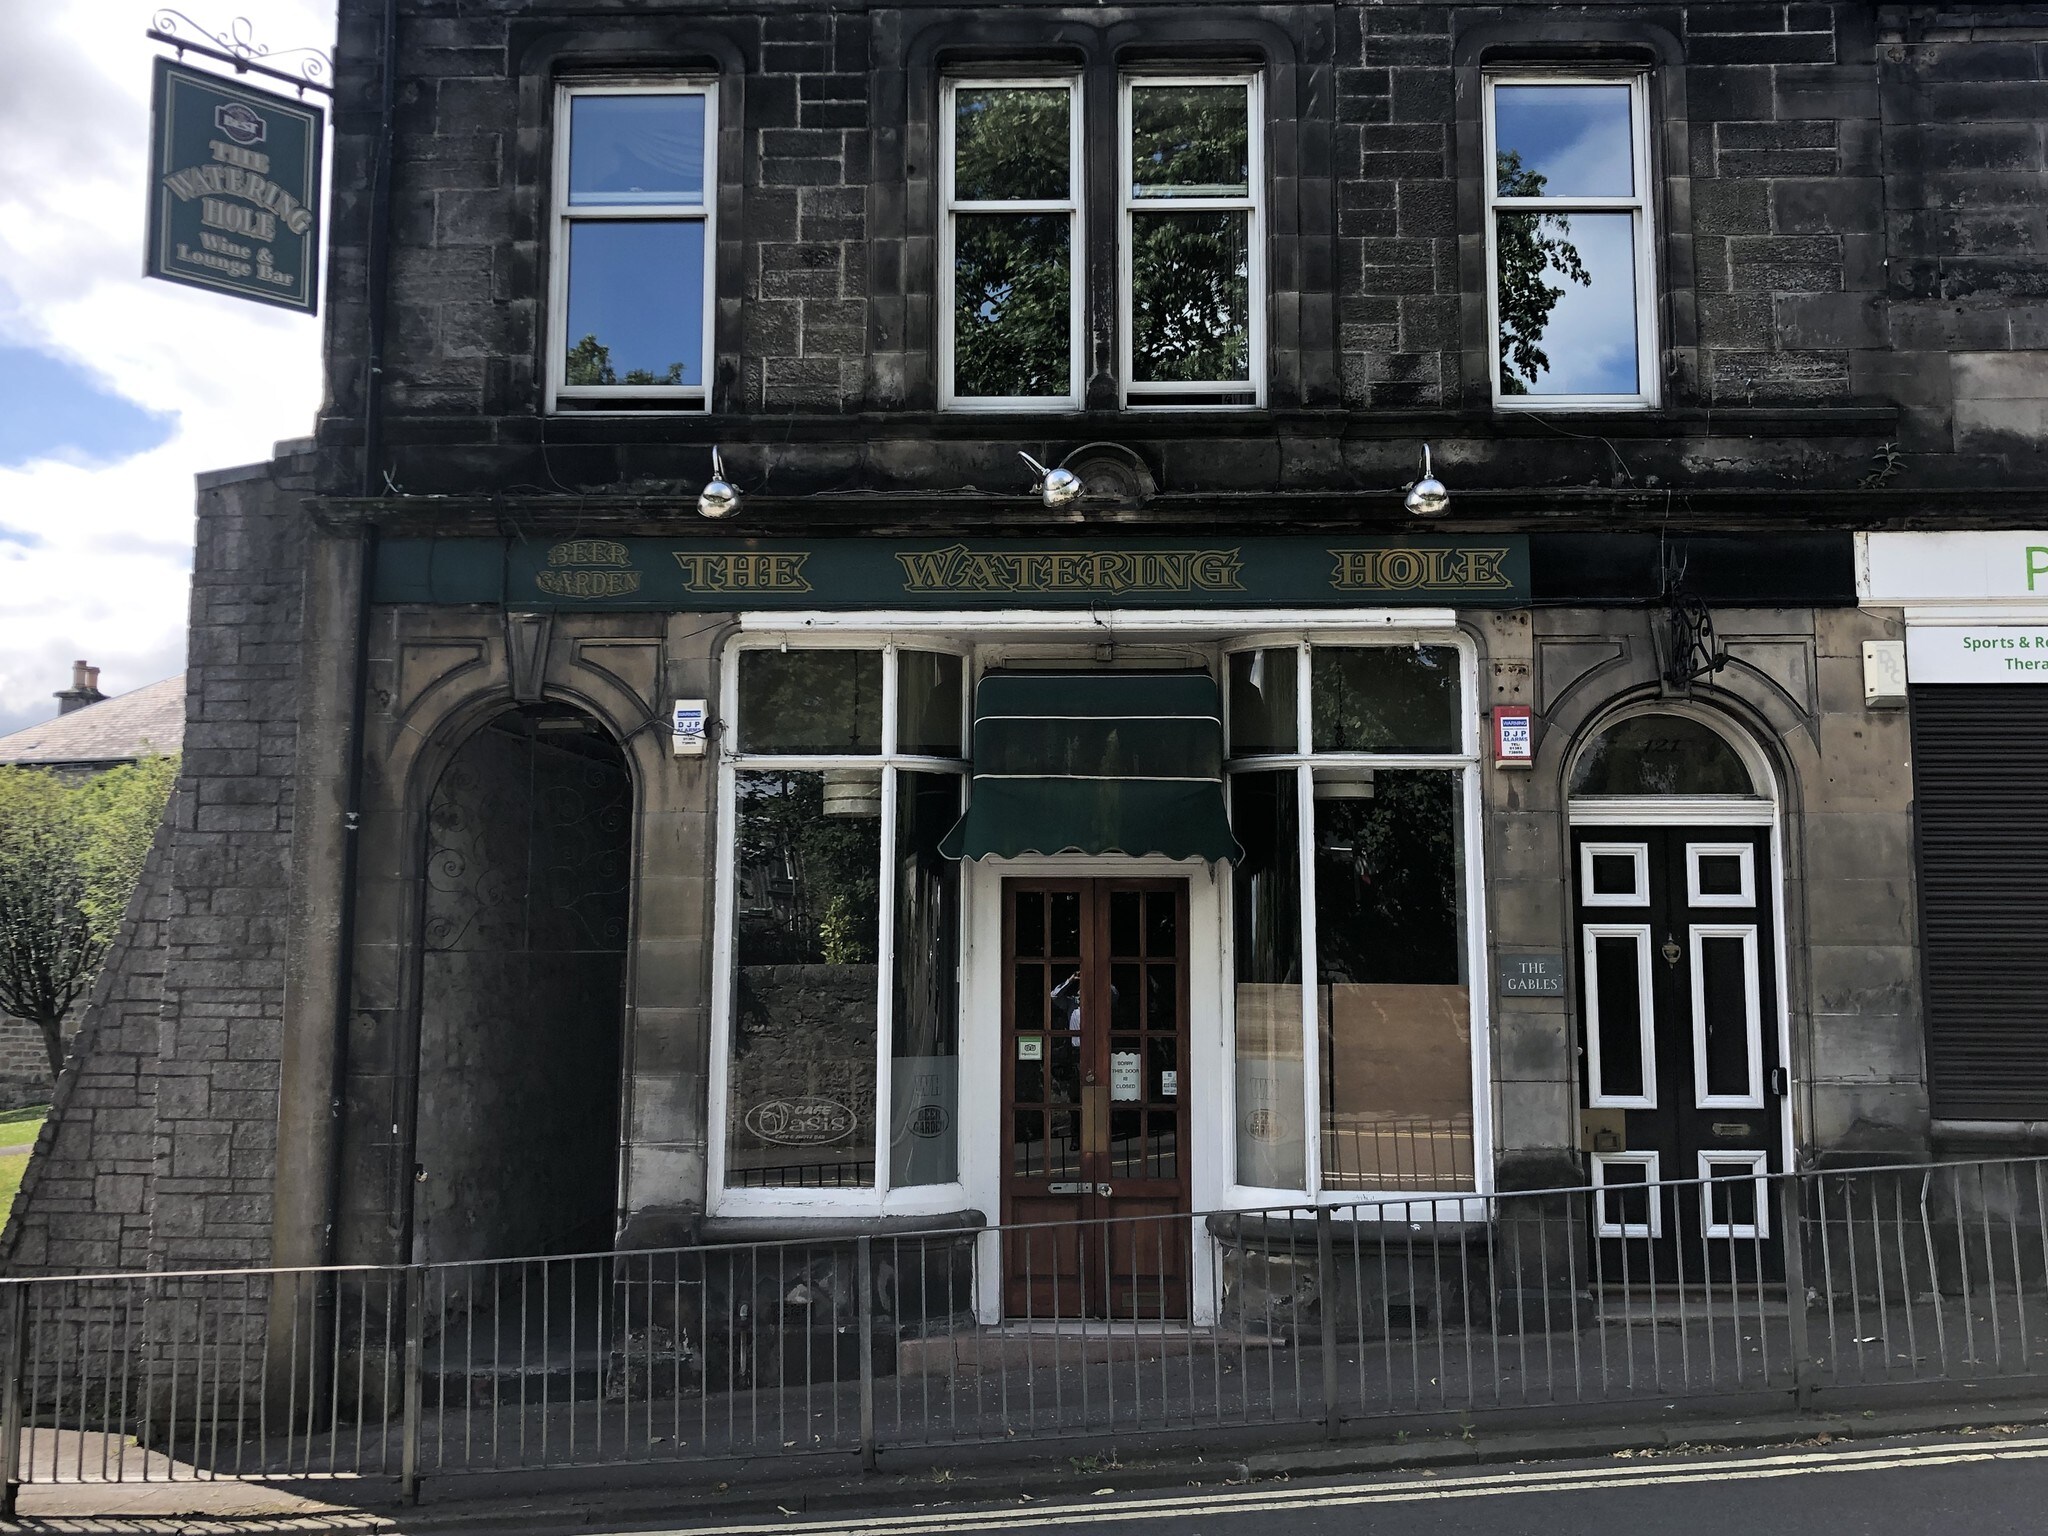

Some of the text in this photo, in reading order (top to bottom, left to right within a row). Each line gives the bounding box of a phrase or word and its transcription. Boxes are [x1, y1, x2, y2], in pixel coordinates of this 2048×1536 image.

[209, 140, 270, 174] THE
[163, 164, 313, 235] WATERING
[202, 197, 276, 243] HOLE
[199, 232, 274, 265] Wine &
[176, 244, 294, 286] Lounge Bar
[548, 539, 632, 567] BEER
[672, 543, 1514, 595] THE WATERING HOLE
[535, 571, 643, 600] GARDEN
[1963, 636, 2048, 651] Sports & R
[1518, 962, 1546, 974] THE
[1508, 978, 1558, 990] GABLES
[913, 1120, 945, 1134] GARDEN
[917, 1107, 940, 1121] BEER
